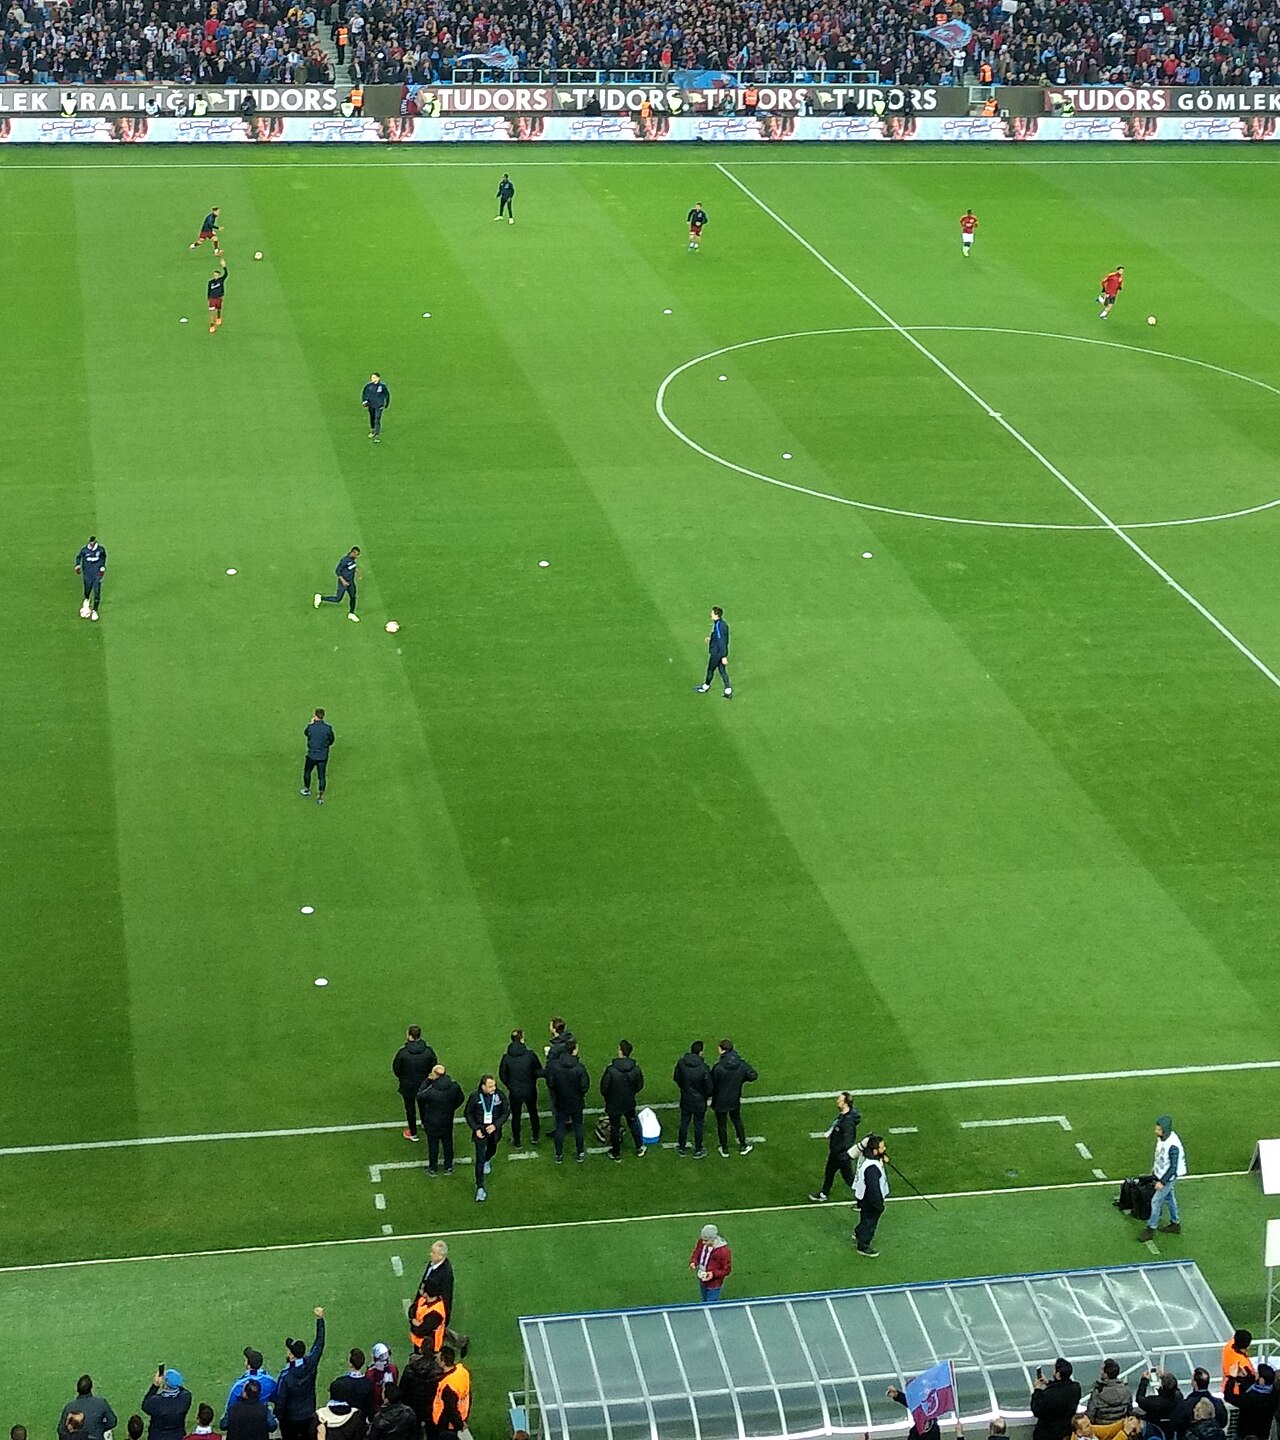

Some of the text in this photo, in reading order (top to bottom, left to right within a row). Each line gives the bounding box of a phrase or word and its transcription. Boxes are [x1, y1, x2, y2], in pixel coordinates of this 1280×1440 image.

[438, 88, 548, 111] TUDORS
[704, 88, 808, 111] TUORS
[1063, 89, 1166, 111] TUDORS
